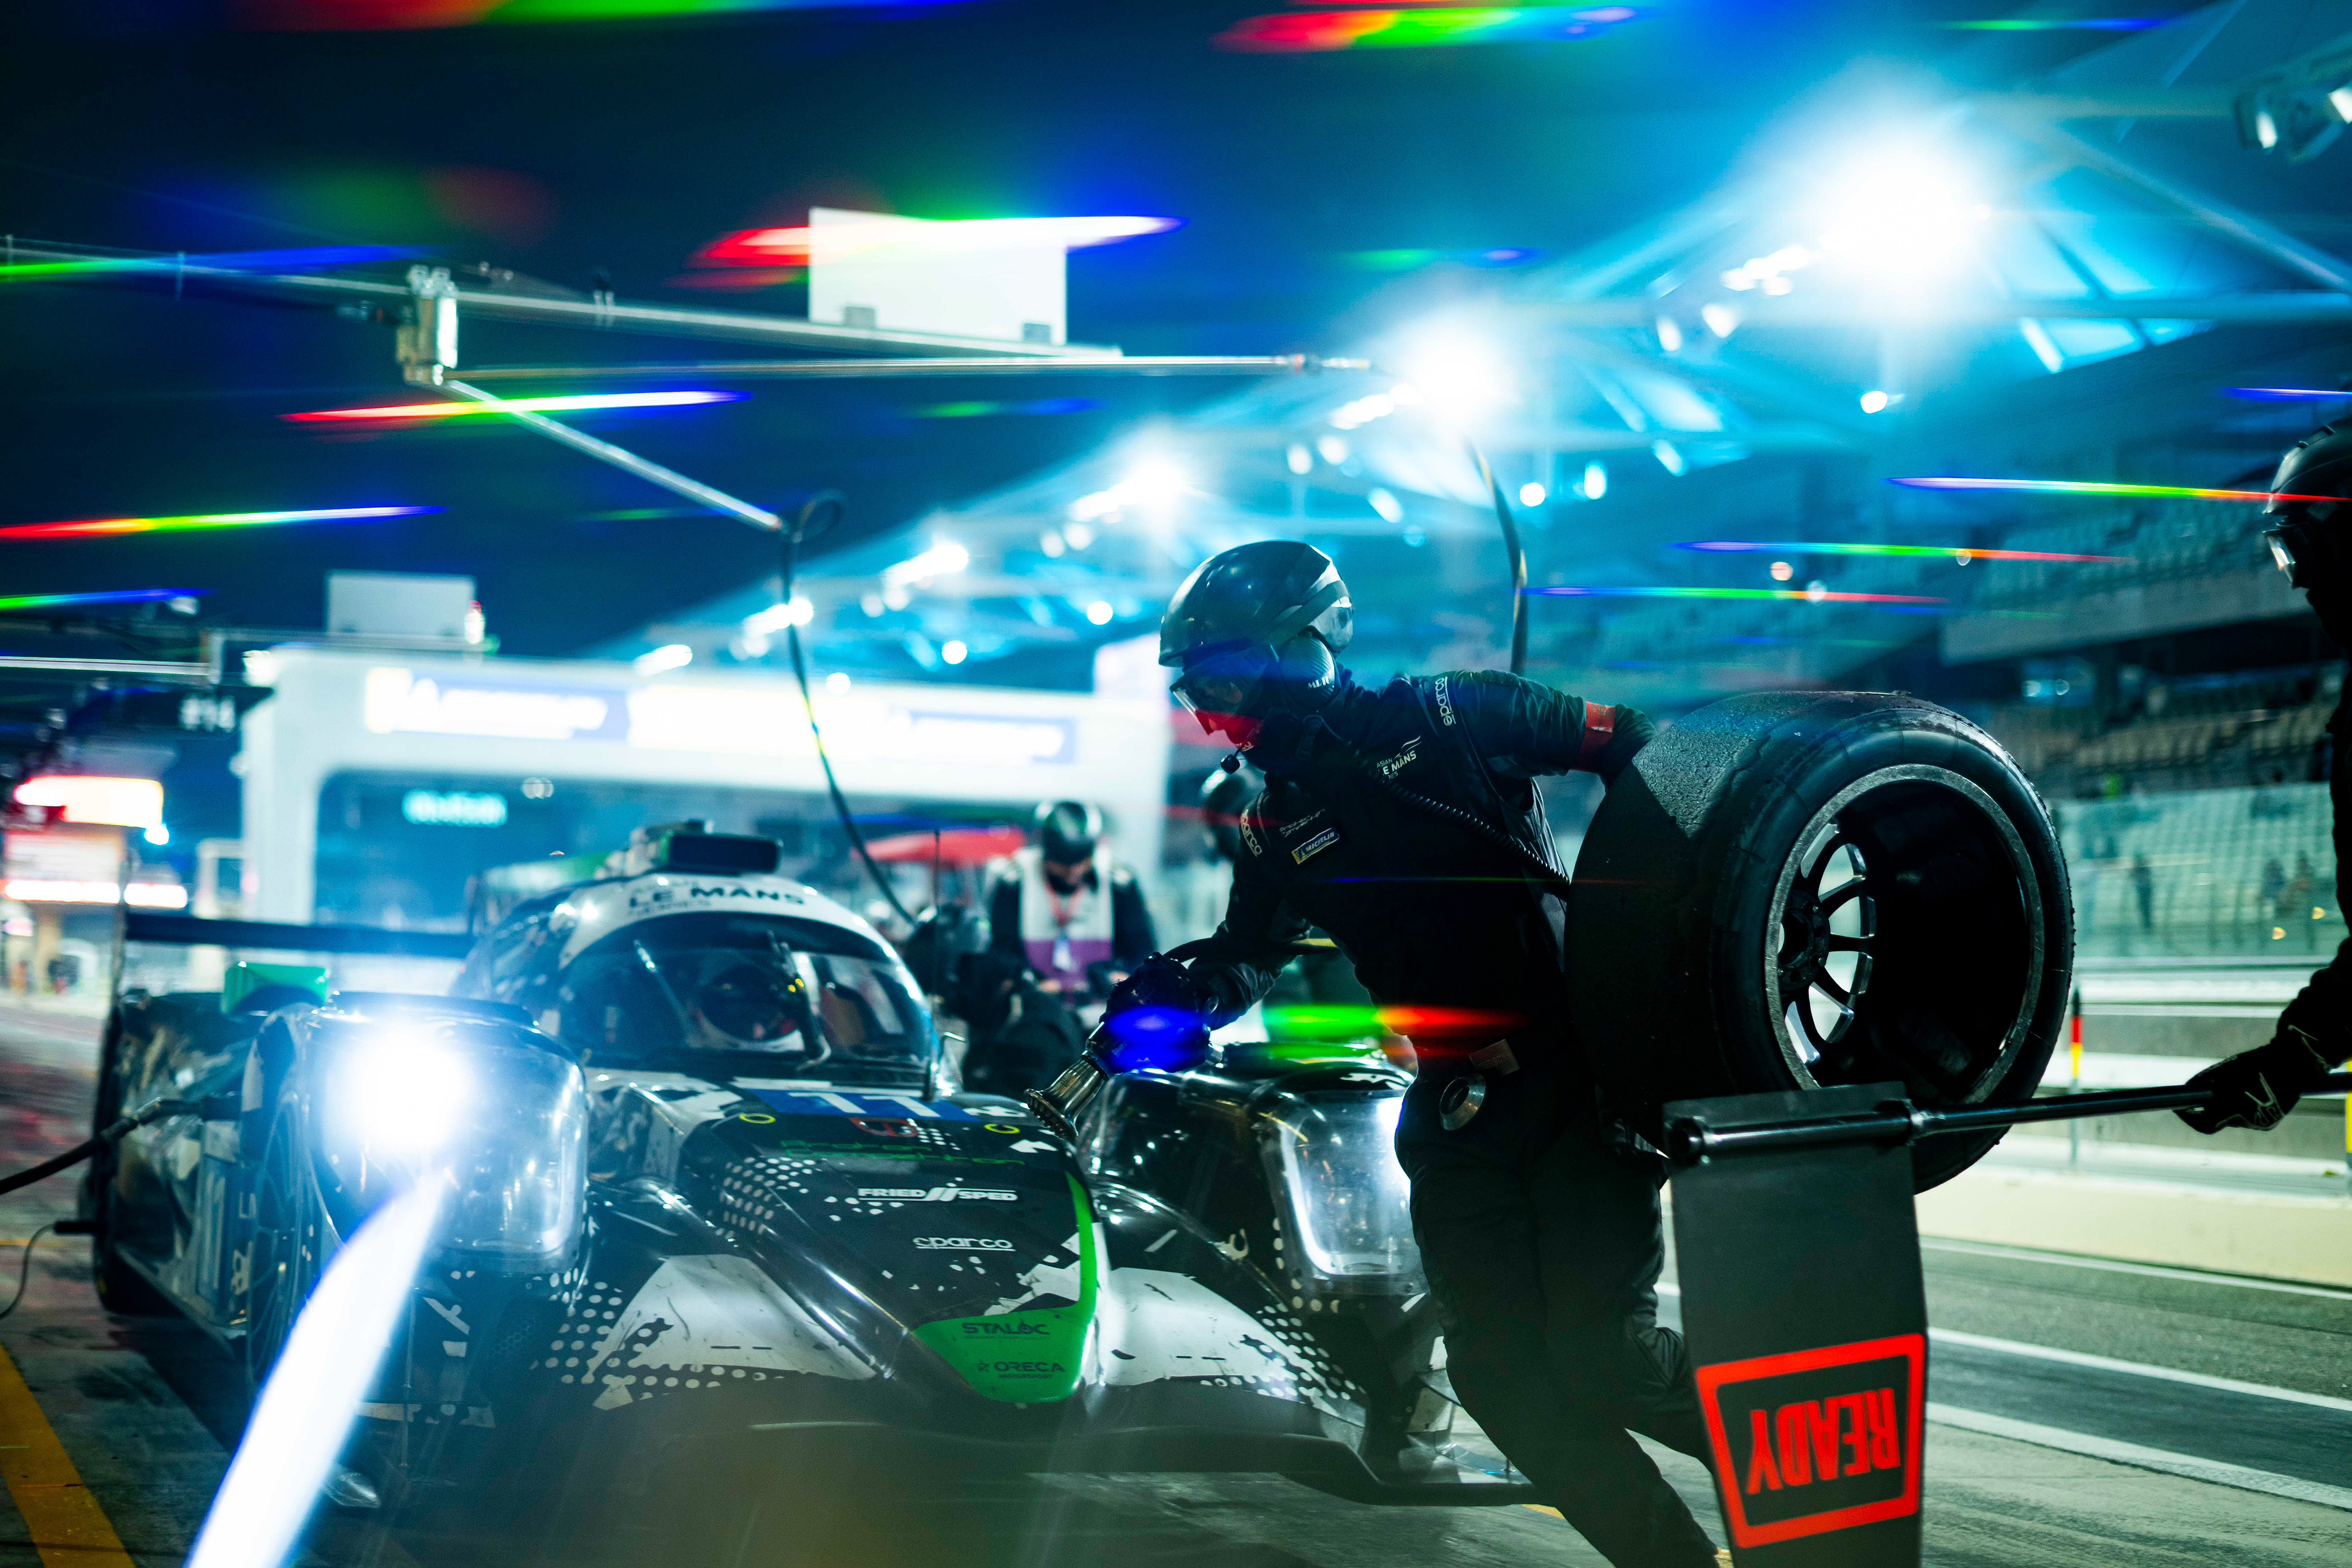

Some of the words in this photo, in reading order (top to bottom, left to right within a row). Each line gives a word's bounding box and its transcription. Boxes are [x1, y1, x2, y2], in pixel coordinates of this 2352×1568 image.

[1377, 758, 1392, 768] ASIAN
[1392, 750, 1417, 772] MANS
[1306, 832, 1335, 851] MICHELIN
[690, 887, 804, 905] MANS
[858, 1188, 926, 1197] FRIED
[957, 1191, 1018, 1201] SPED
[913, 1237, 1013, 1250] sparco
[994, 1361, 1066, 1373] ORECA
[1746, 1389, 1899, 1494] READY
